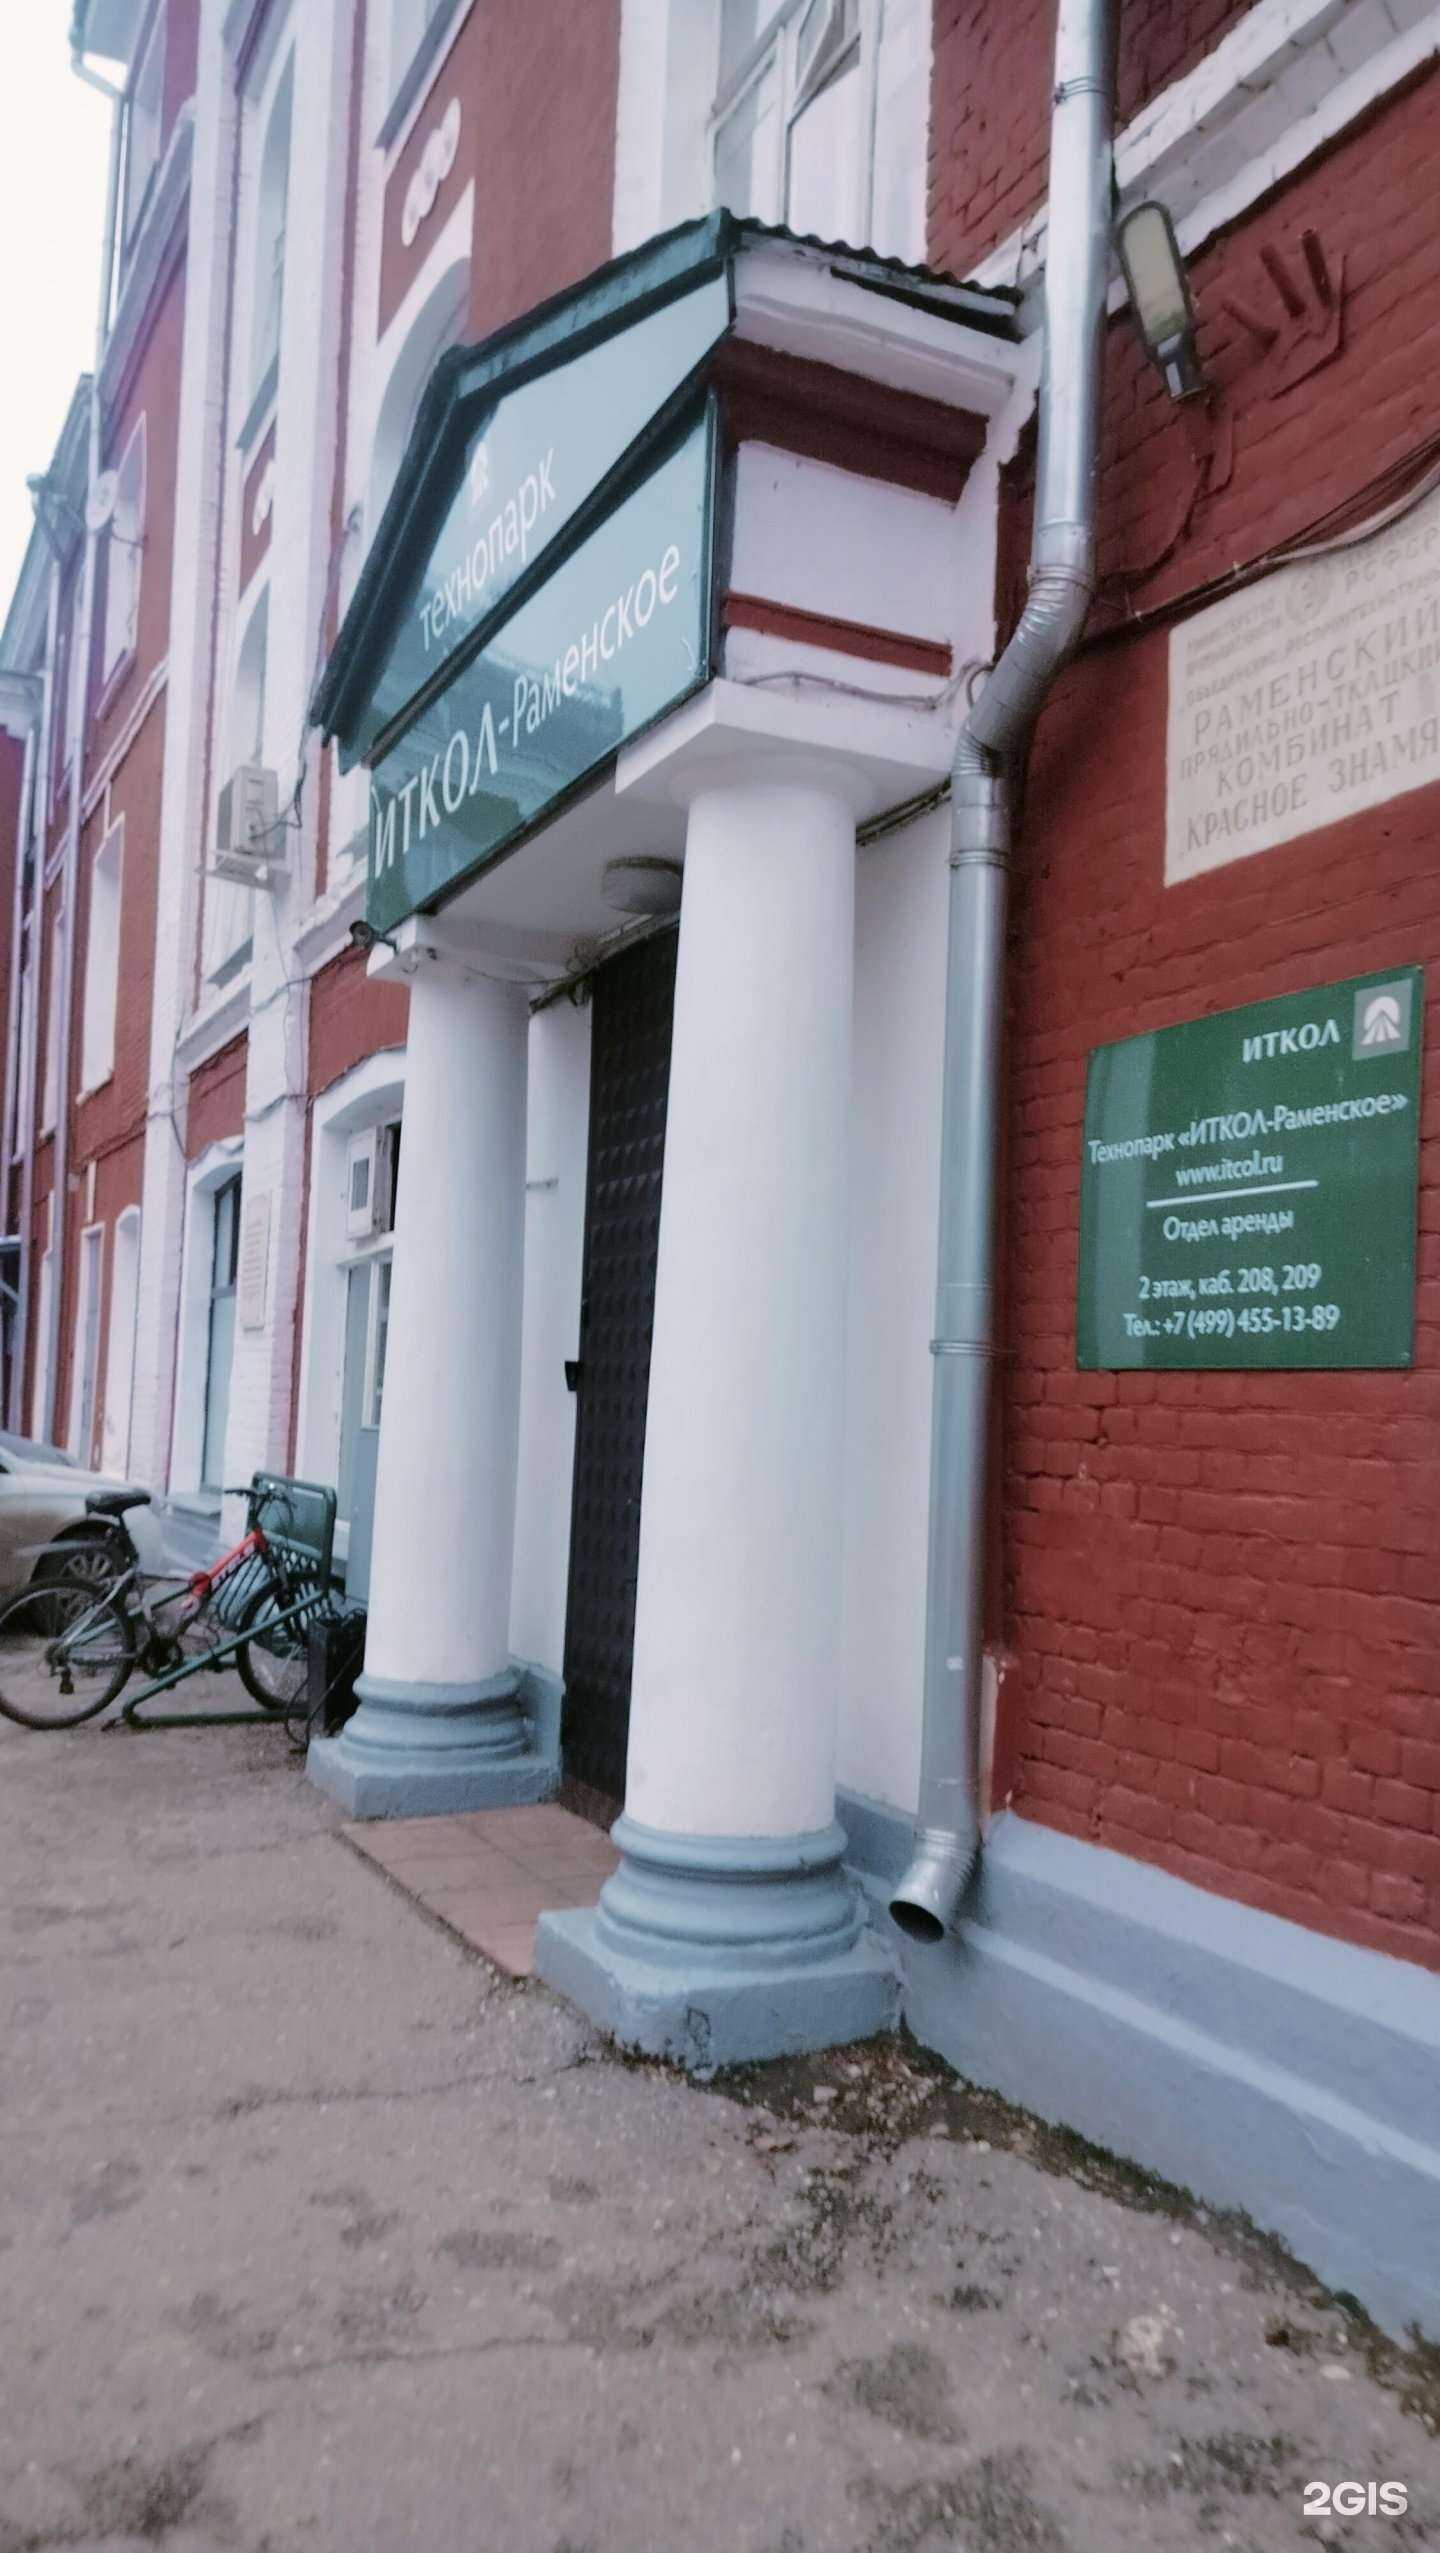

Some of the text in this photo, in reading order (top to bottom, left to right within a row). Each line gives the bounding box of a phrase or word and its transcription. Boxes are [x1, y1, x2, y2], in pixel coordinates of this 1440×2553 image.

[419, 447, 556, 652] технопарк
[1194, 594, 1439, 745] РАМЕНСКИЙ
[373, 544, 681, 878] ИТКОЛ-Раменское
[1216, 690, 1399, 798] КОМБИНАТ
[1186, 716, 1439, 852] КРАСНОЕ ЗНАМЯ
[1242, 1018, 1340, 1063] ИТКОЛ
[1088, 1093, 1408, 1163] Технопарк «ИТКОЛ-Раменское»
[1176, 1150, 1284, 1187] www.itcol.ru
[1163, 1210, 1294, 1242] Отдел аренды
[1138, 1263, 1322, 1300] 2 этаж, каб. 208, 209
[1123, 1304, 1341, 1339] Тел.: +7 (499) 455-13-89
